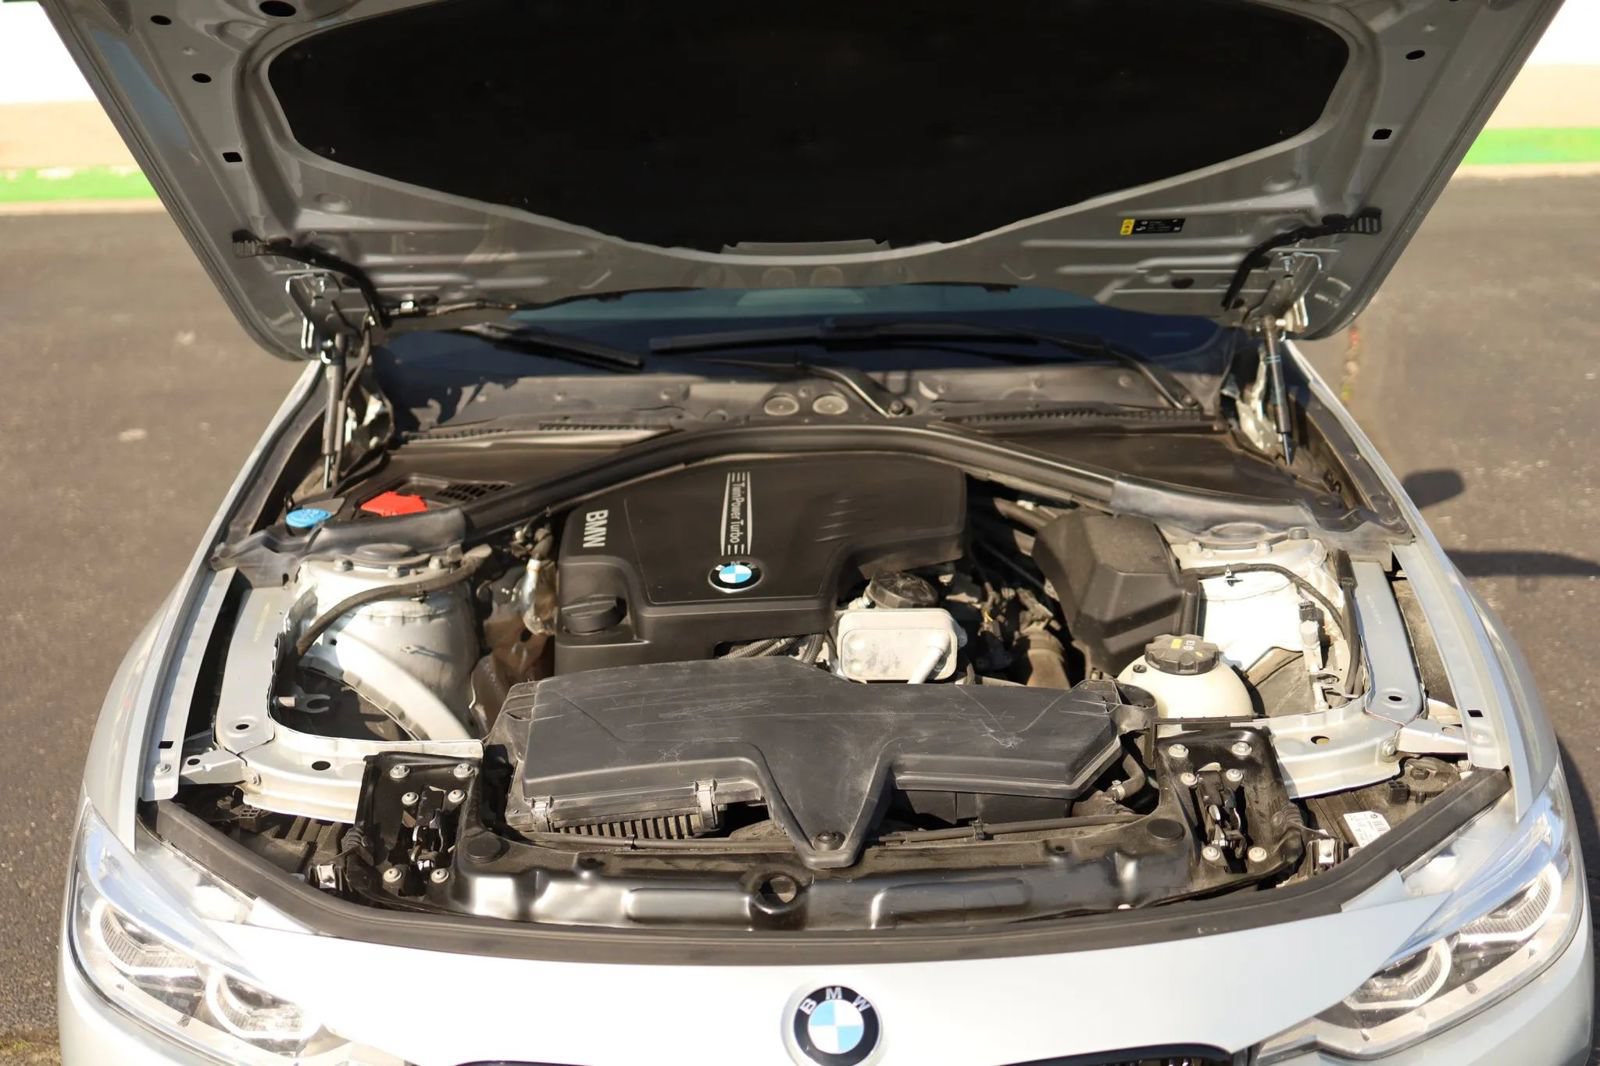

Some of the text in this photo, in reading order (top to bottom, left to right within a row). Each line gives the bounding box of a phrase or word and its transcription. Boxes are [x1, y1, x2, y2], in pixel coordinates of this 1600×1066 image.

[583, 509, 608, 547] BMW
[730, 482, 745, 543] TwinPower Turbo
[800, 987, 871, 1015] BMW
